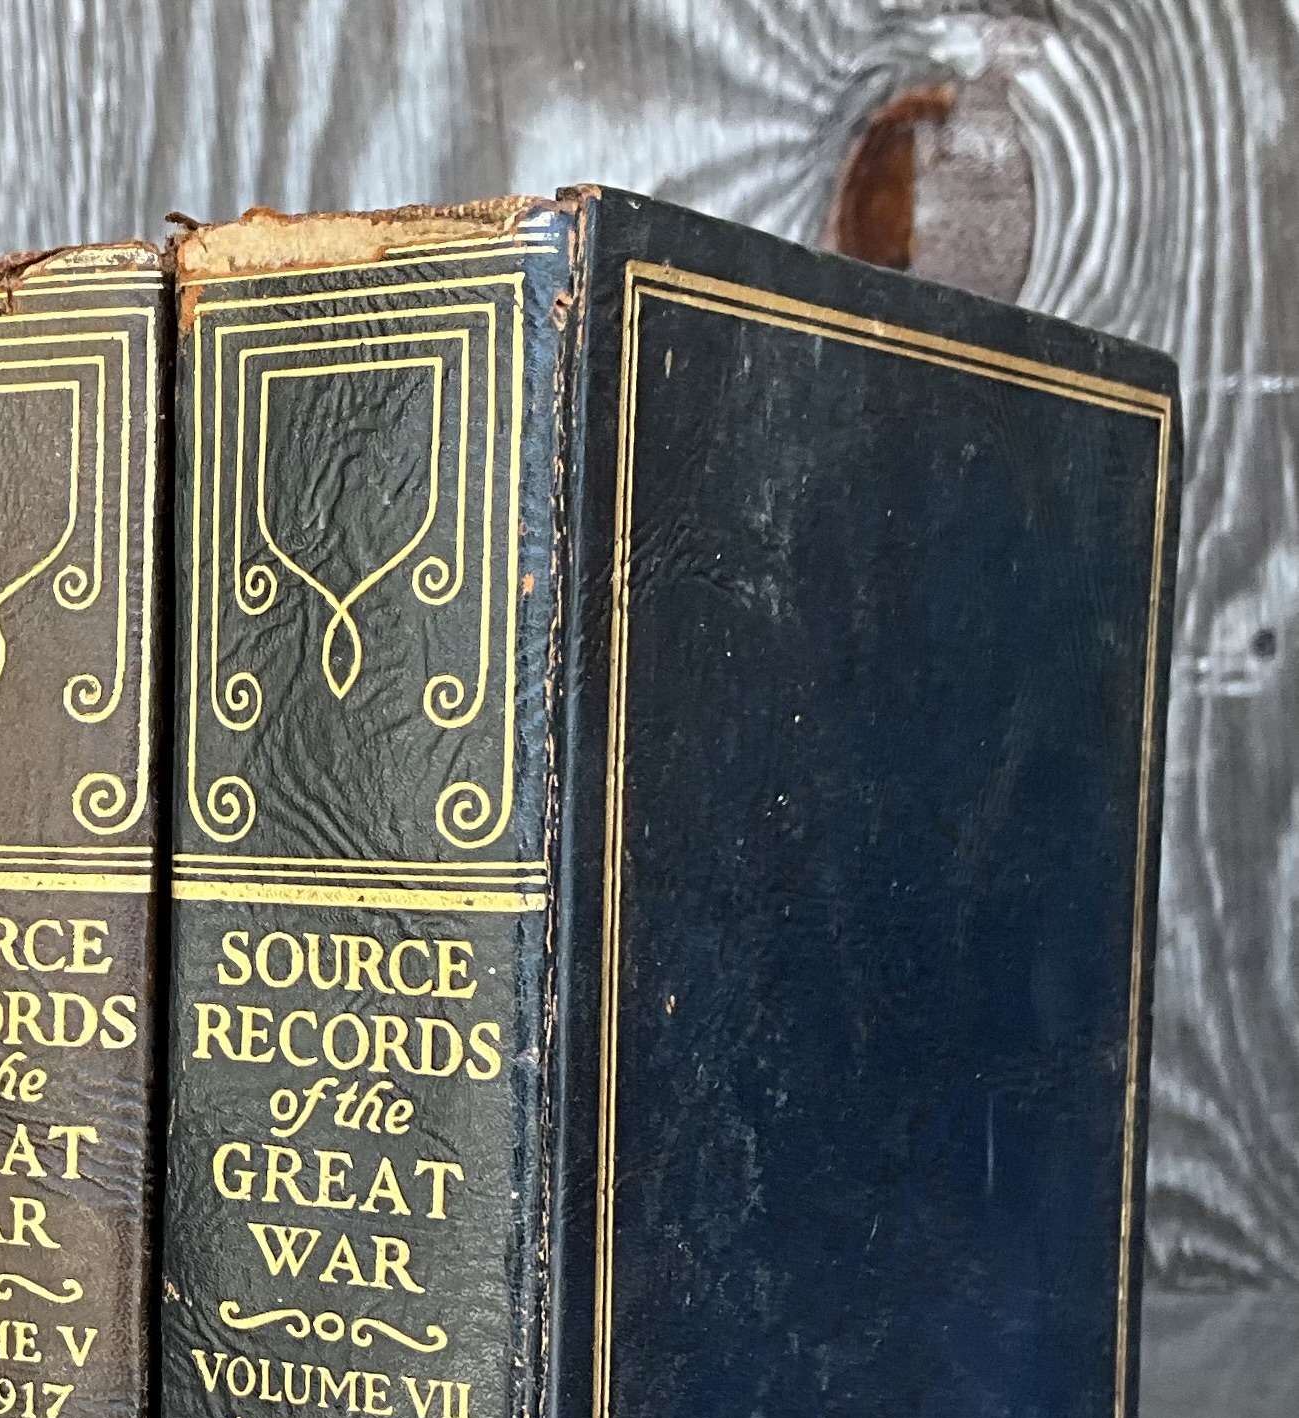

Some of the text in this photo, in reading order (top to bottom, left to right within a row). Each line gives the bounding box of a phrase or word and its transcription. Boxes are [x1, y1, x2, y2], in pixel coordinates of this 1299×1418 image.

[217, 930, 477, 999] SOURCE
[192, 1003, 501, 1081] RECORDS
[269, 1077, 415, 1138] of the
[212, 1142, 464, 1220] GREAT
[247, 1222, 425, 1294] WAR
[58, 1326, 98, 1367] V
[191, 1349, 392, 1417] VOLUME
